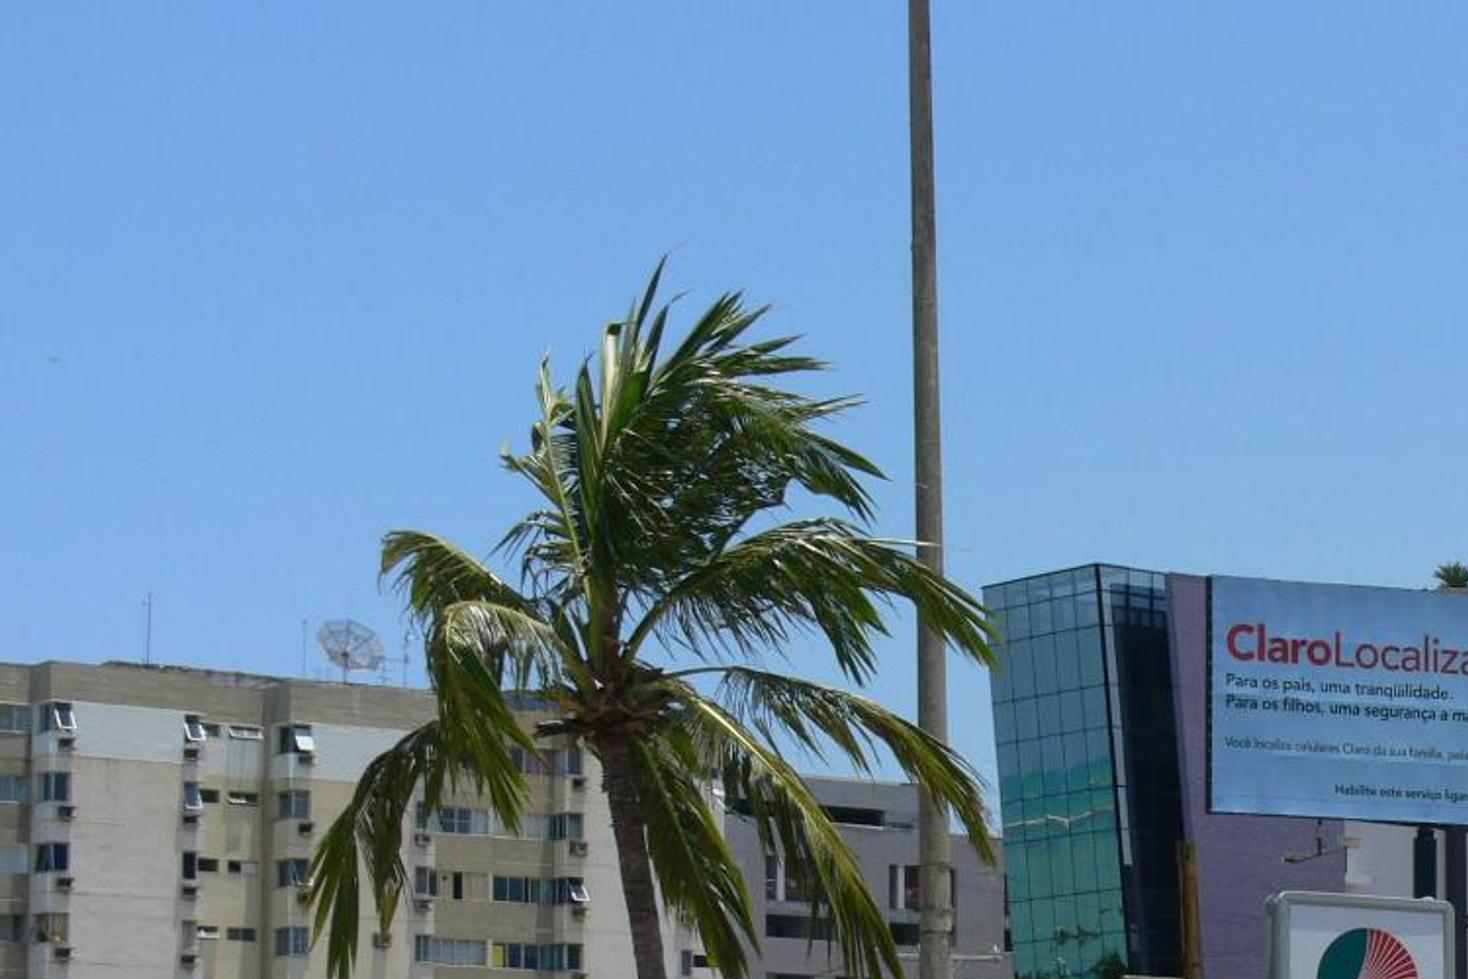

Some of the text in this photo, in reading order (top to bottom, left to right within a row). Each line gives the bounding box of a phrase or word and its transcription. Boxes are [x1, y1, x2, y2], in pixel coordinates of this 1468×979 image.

[1225, 673, 1258, 689] Para
[1262, 677, 1279, 690] os
[1283, 676, 1315, 693] pais,
[1321, 682, 1351, 695] uma
[1225, 694, 1258, 710] Para
[1262, 699, 1279, 712] os
[1284, 697, 1325, 715] filhos,
[1329, 703, 1360, 717] uma
[1364, 706, 1436, 722] segurança
[1440, 710, 1448, 721] a
